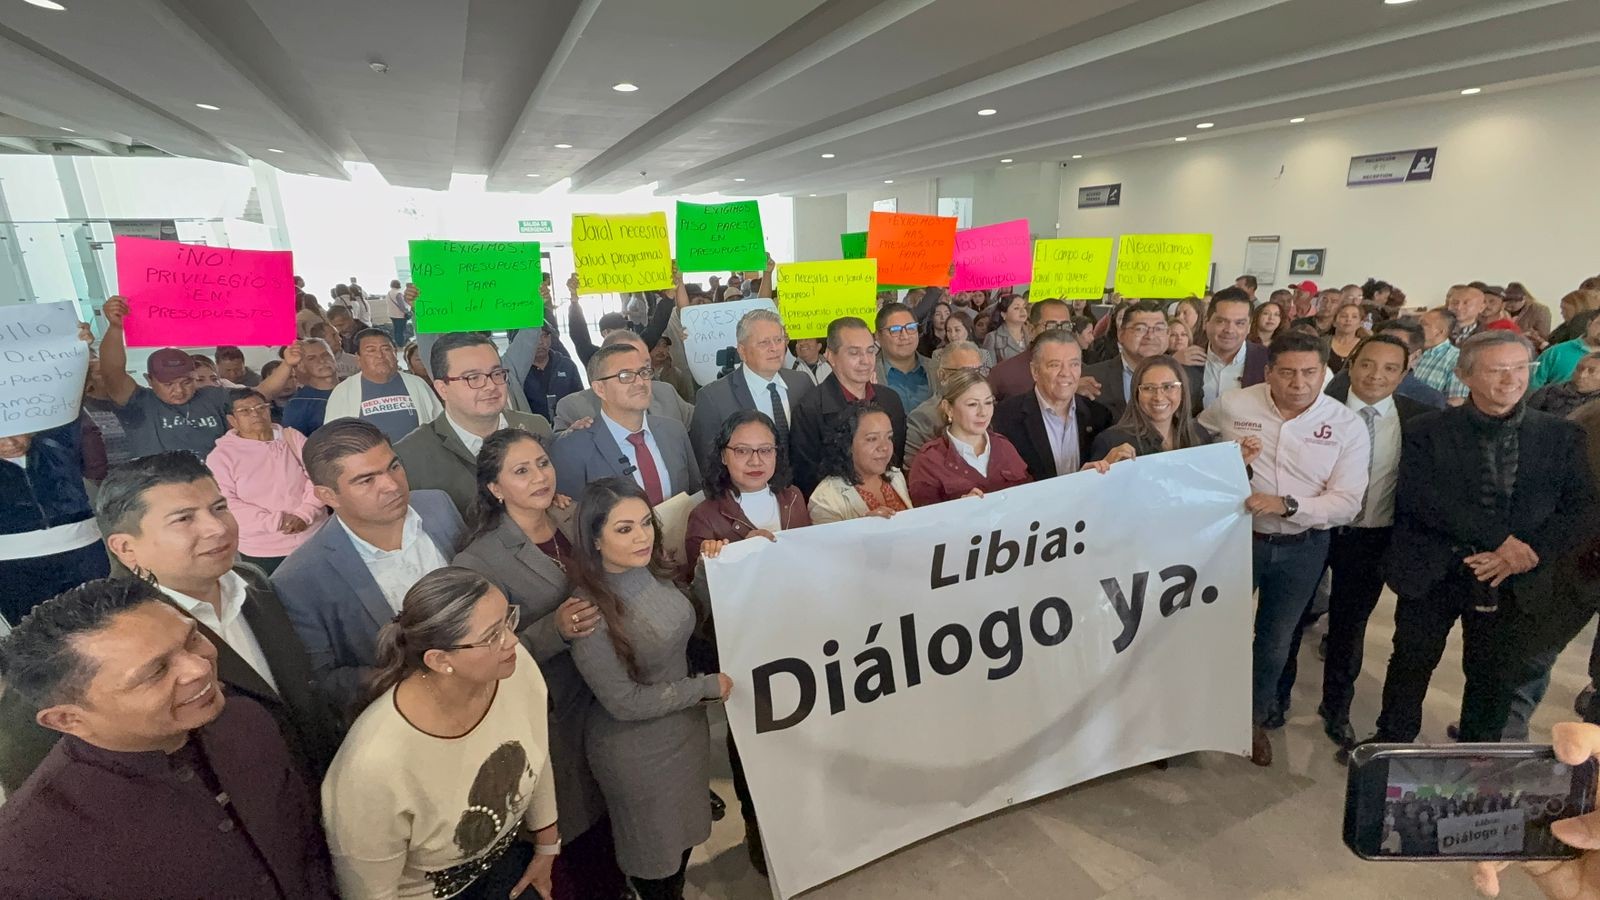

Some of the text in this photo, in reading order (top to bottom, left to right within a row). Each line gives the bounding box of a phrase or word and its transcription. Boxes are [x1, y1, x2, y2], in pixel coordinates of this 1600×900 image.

[574, 215, 667, 241] Jaral necesita
[680, 218, 707, 231] PISO
[689, 242, 759, 257] PRESUPUESTO
[1036, 242, 1047, 262] El
[1081, 250, 1094, 263] de
[610, 249, 664, 270] programas
[411, 260, 541, 276] MAS PRESUPUESTO
[1158, 261, 1170, 271] no
[1173, 260, 1192, 275] que
[579, 274, 594, 288] de
[597, 272, 633, 289] apoyo
[795, 272, 829, 284] necesita
[834, 275, 844, 283] un
[1137, 275, 1146, 283] lo
[466, 280, 497, 292] PARA
[148, 305, 273, 319] PRESUPUESTO
[416, 300, 454, 318] Jaral
[465, 298, 483, 312] del
[694, 330, 726, 343] PARA
[382, 396, 407, 404] WHITE
[1233, 420, 1262, 429] morena
[929, 519, 1086, 590] Libia:
[751, 563, 1220, 735] Diálogo ya.
[1442, 827, 1498, 847] Diálogo
